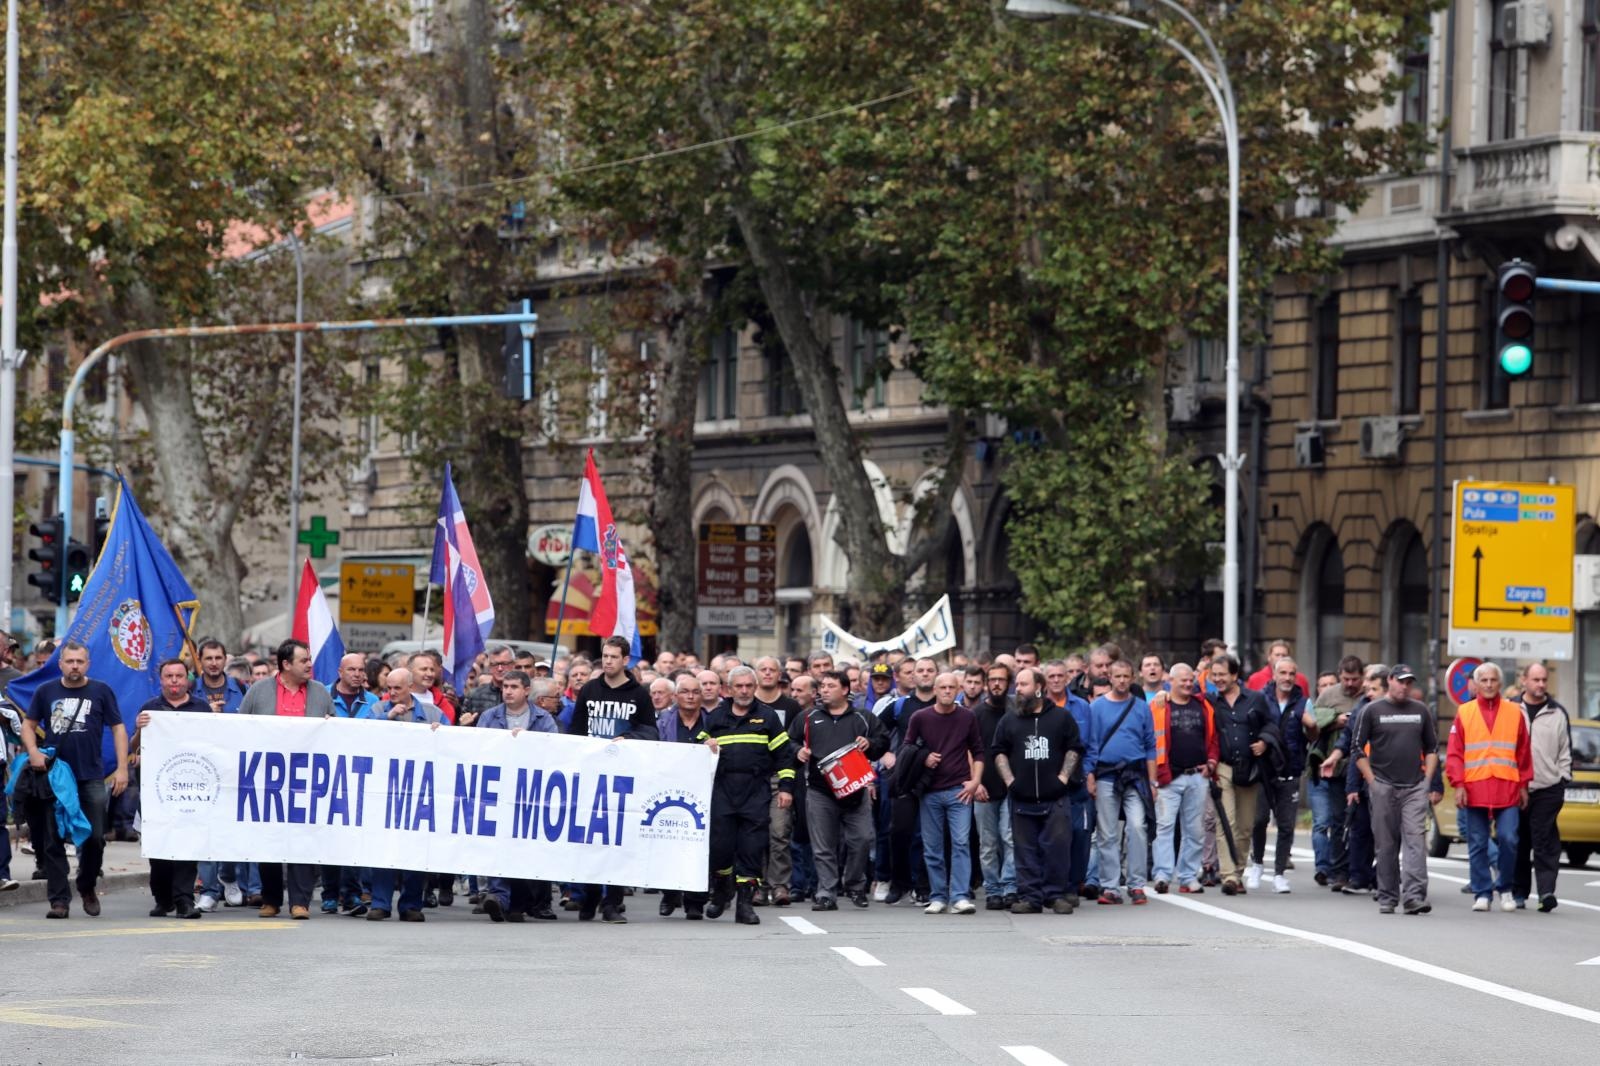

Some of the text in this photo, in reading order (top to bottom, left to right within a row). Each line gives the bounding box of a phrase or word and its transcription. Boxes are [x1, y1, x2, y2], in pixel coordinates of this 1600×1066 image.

[1463, 524, 1498, 537] Opatija
[1507, 586, 1544, 602] Zagreb
[1500, 637, 1531, 652] 50 m
[236, 750, 635, 847] KREPAT MA NE MOLAT
[659, 819, 689, 828] SMH-IS
